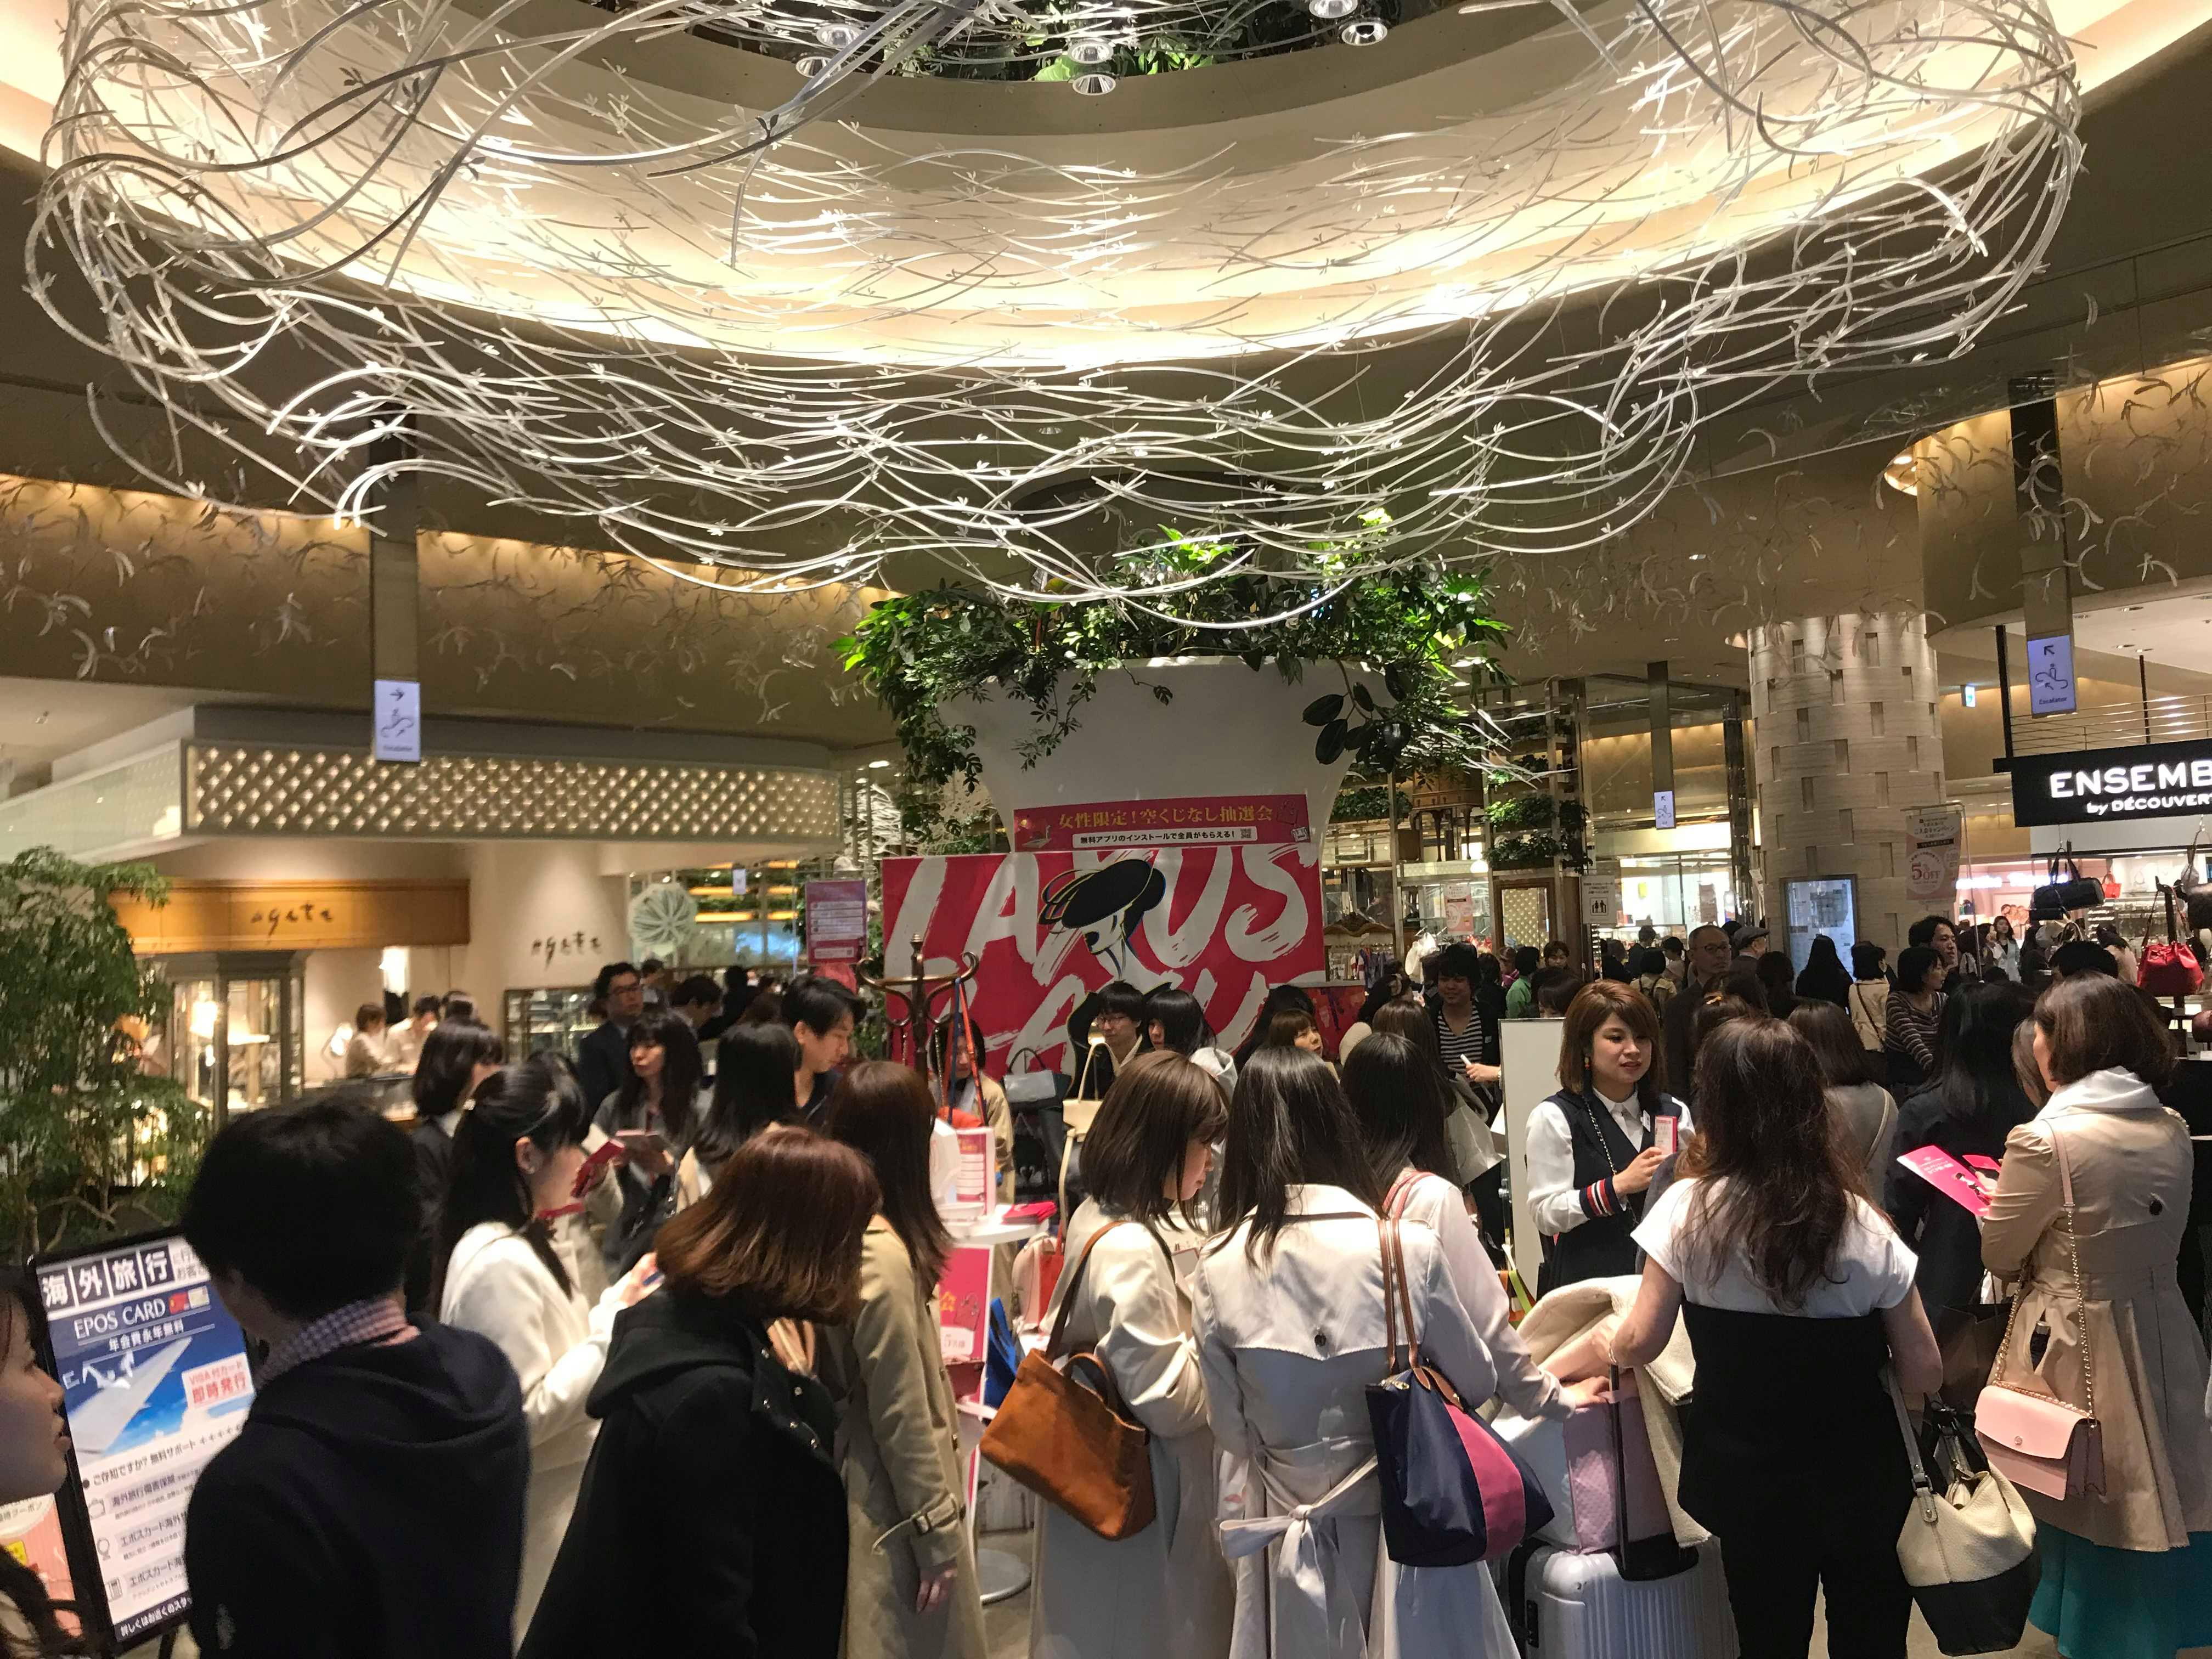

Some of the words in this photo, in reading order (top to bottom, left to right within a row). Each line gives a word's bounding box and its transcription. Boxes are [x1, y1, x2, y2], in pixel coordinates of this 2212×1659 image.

[2050, 760, 2212, 798] ENSEMB
[1058, 805, 1273, 830] 女性限定！空くじなし抽選会
[2087, 802, 2109, 815] by
[1080, 827, 1235, 844] 無料アプリのインストールで全員がもらえる！
[42, 1250, 168, 1308] 海外旅行
[74, 1310, 119, 1340] EPOS
[122, 1298, 166, 1326] CARD
[193, 1373, 247, 1404] 即時発行
